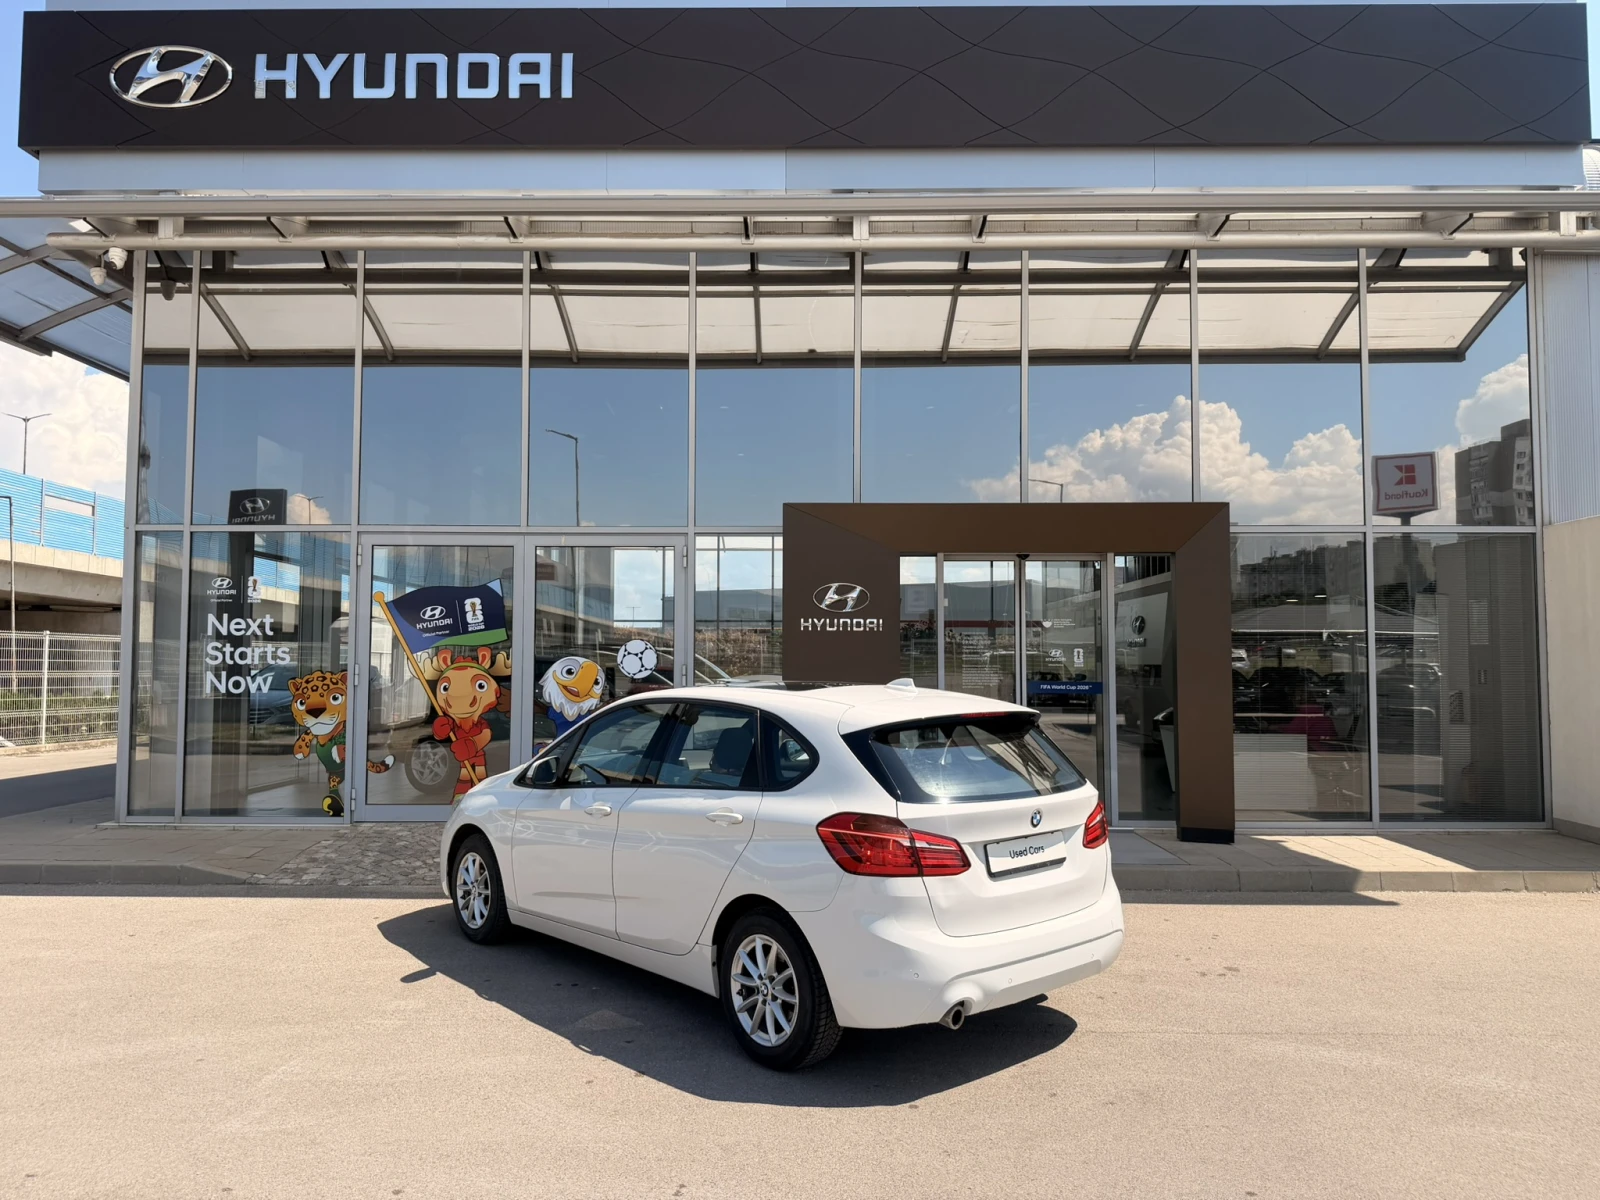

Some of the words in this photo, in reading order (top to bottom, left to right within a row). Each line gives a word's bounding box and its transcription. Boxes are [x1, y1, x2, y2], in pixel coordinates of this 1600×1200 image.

[254, 52, 574, 100] HYUNDAI
[206, 613, 274, 636] Next
[416, 617, 453, 630] HYUNDAI
[800, 618, 883, 631] HYUNDAI
[205, 642, 291, 665] Starts
[205, 671, 273, 694] Now
[1009, 847, 1028, 859] Used
[1028, 845, 1045, 855] Cars
